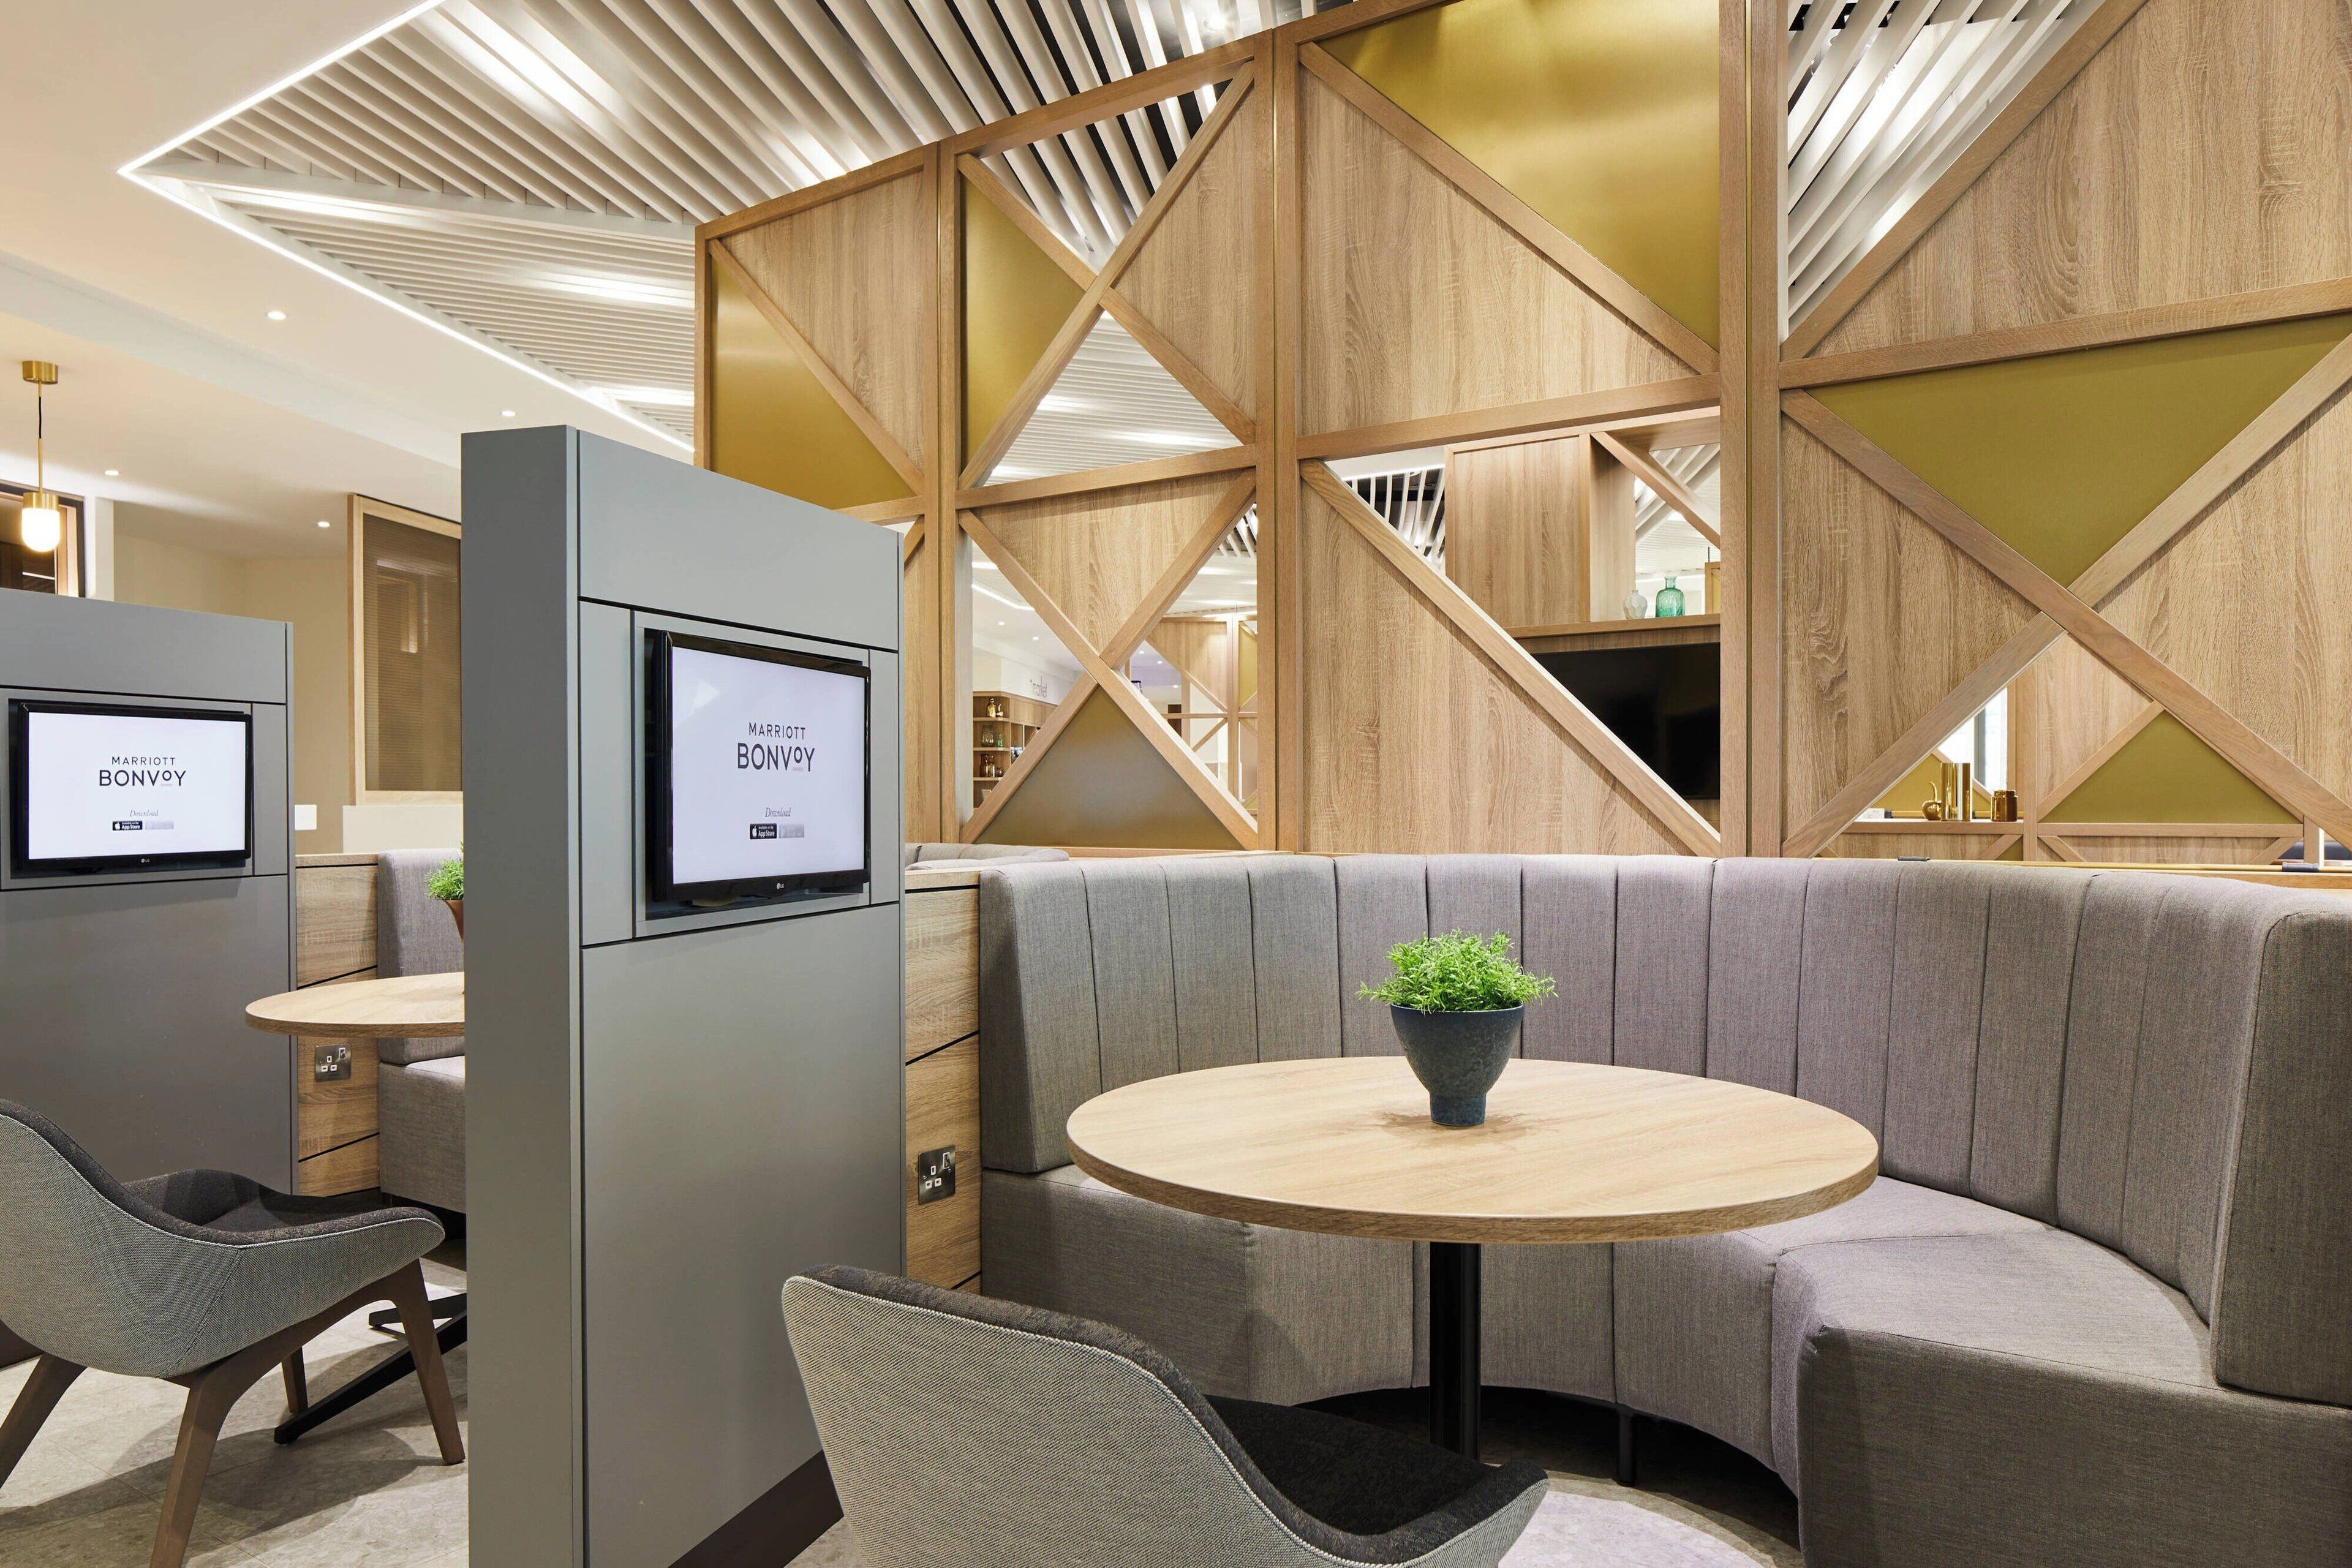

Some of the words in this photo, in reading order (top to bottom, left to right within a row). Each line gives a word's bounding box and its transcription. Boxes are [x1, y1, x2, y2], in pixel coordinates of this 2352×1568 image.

[748, 722, 805, 740] MARRIOTT
[111, 756, 176, 766] MARRIOTT
[737, 742, 815, 772] BONVOY
[99, 769, 186, 786] BONVOY
[764, 807, 791, 818] Download
